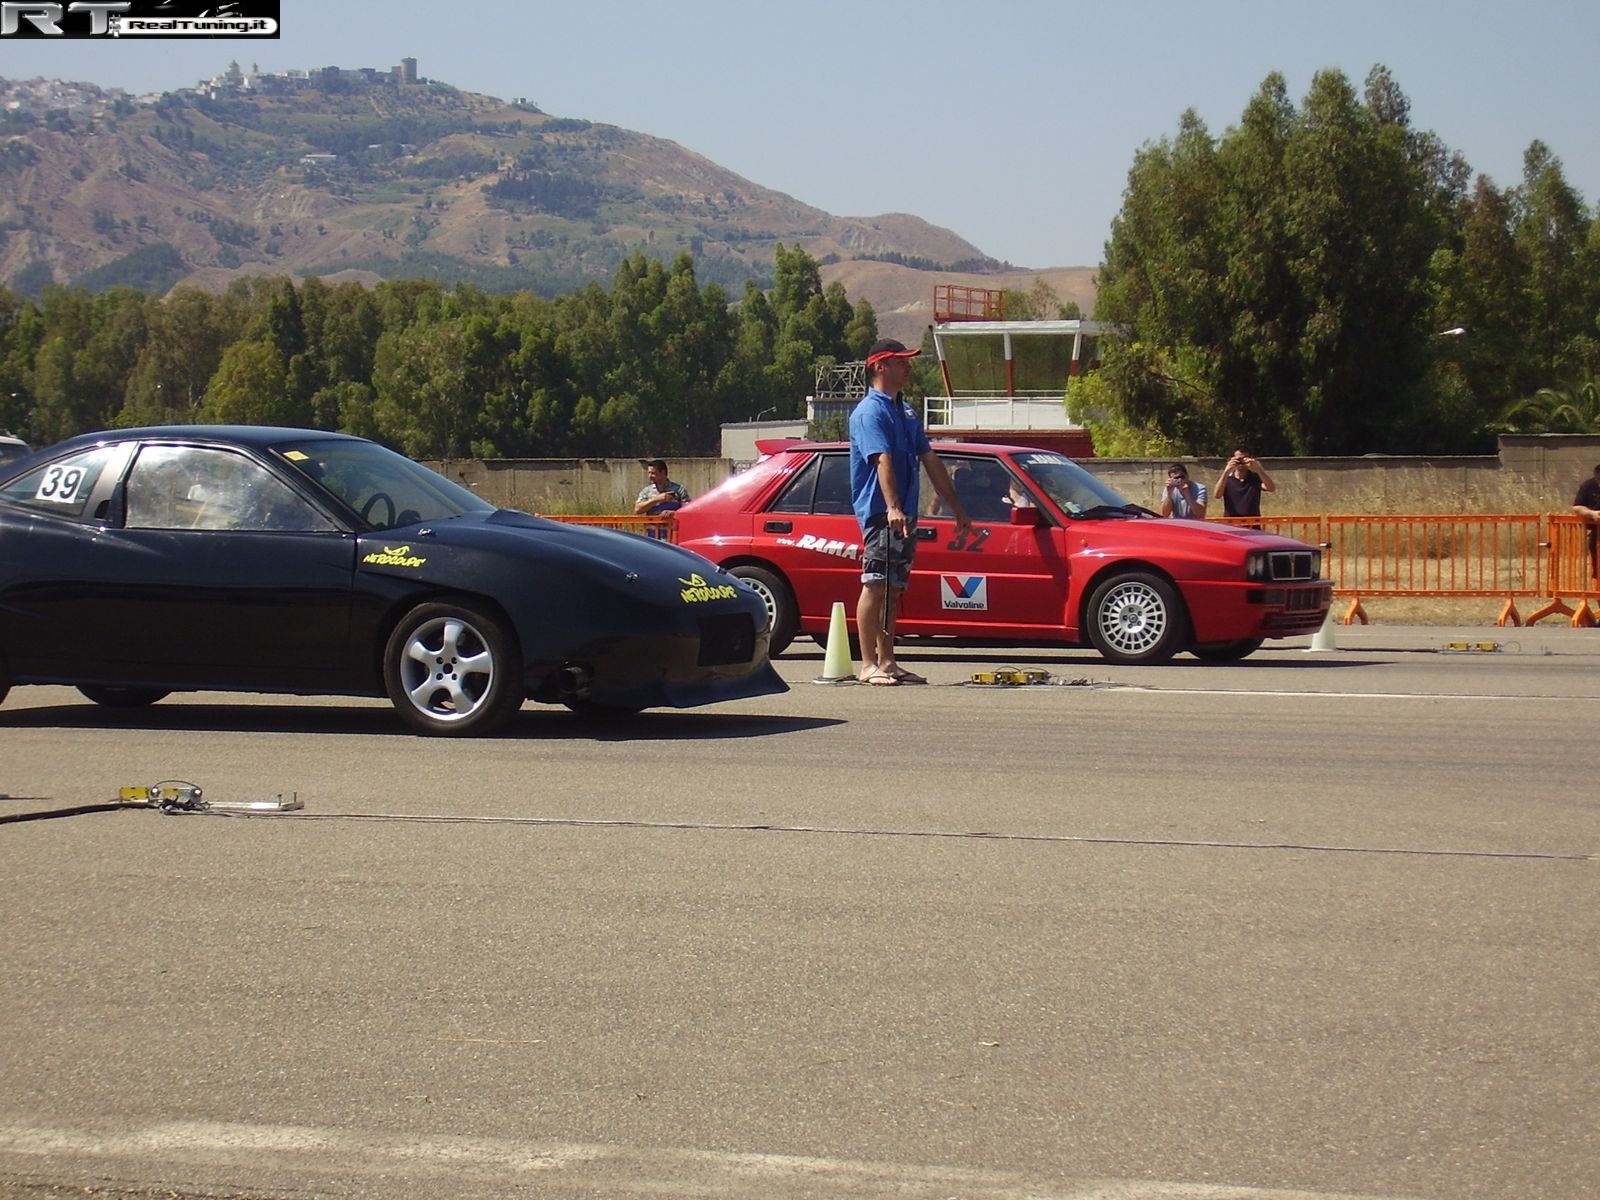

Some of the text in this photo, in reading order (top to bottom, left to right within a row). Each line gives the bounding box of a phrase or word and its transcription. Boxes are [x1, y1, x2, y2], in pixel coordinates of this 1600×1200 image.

[42, 467, 81, 499] 39
[946, 527, 990, 553] 32
[943, 600, 985, 610] Valvoline
